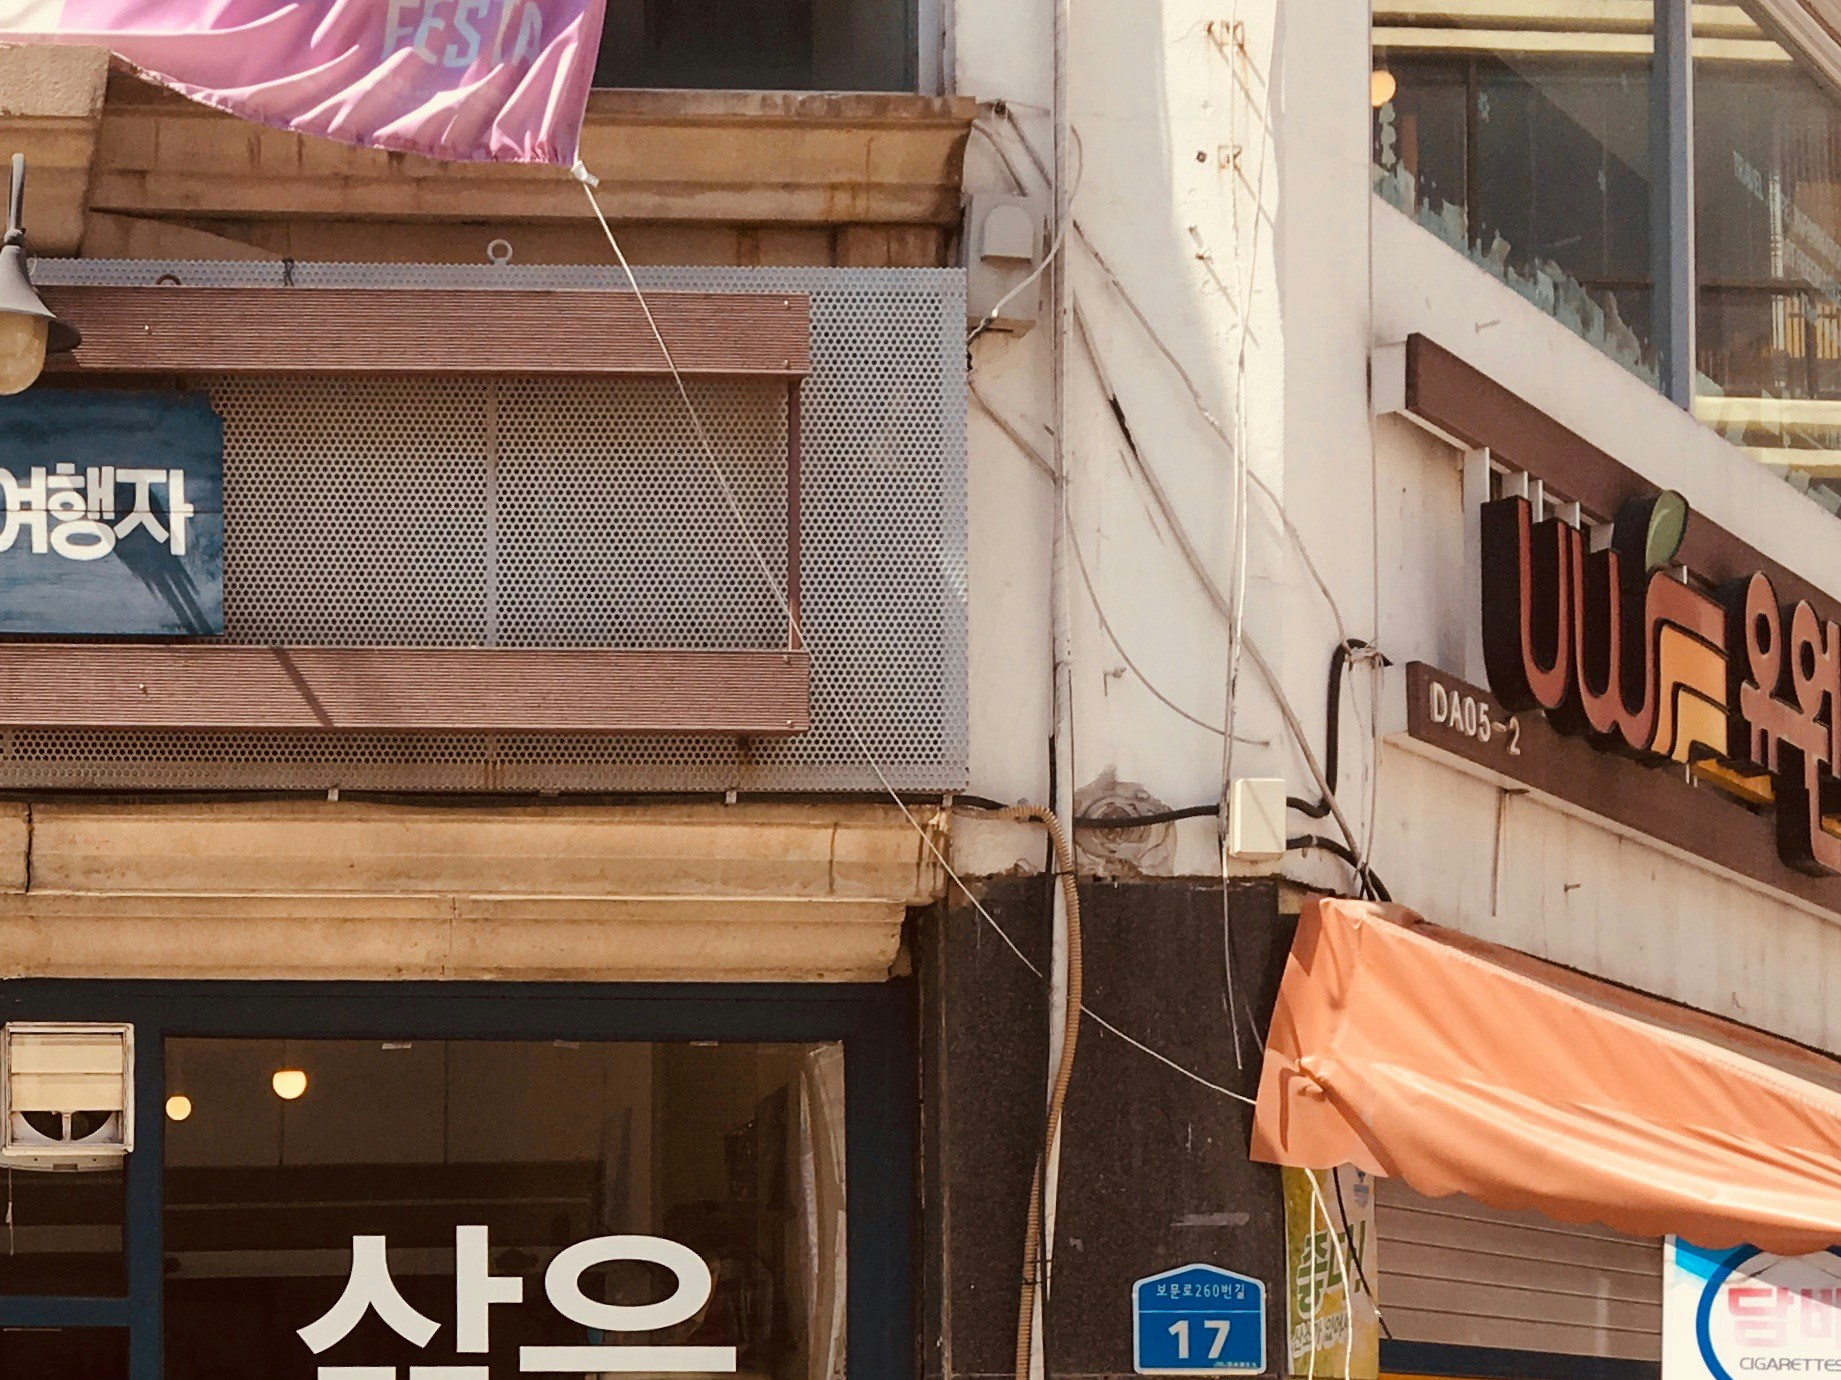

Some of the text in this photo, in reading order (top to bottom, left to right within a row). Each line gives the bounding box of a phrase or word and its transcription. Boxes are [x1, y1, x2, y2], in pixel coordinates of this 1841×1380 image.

[1428, 680, 1522, 757] DA05-2
[1156, 1283, 1245, 1300] 보문로260번길
[1168, 1320, 1230, 1359] 17
